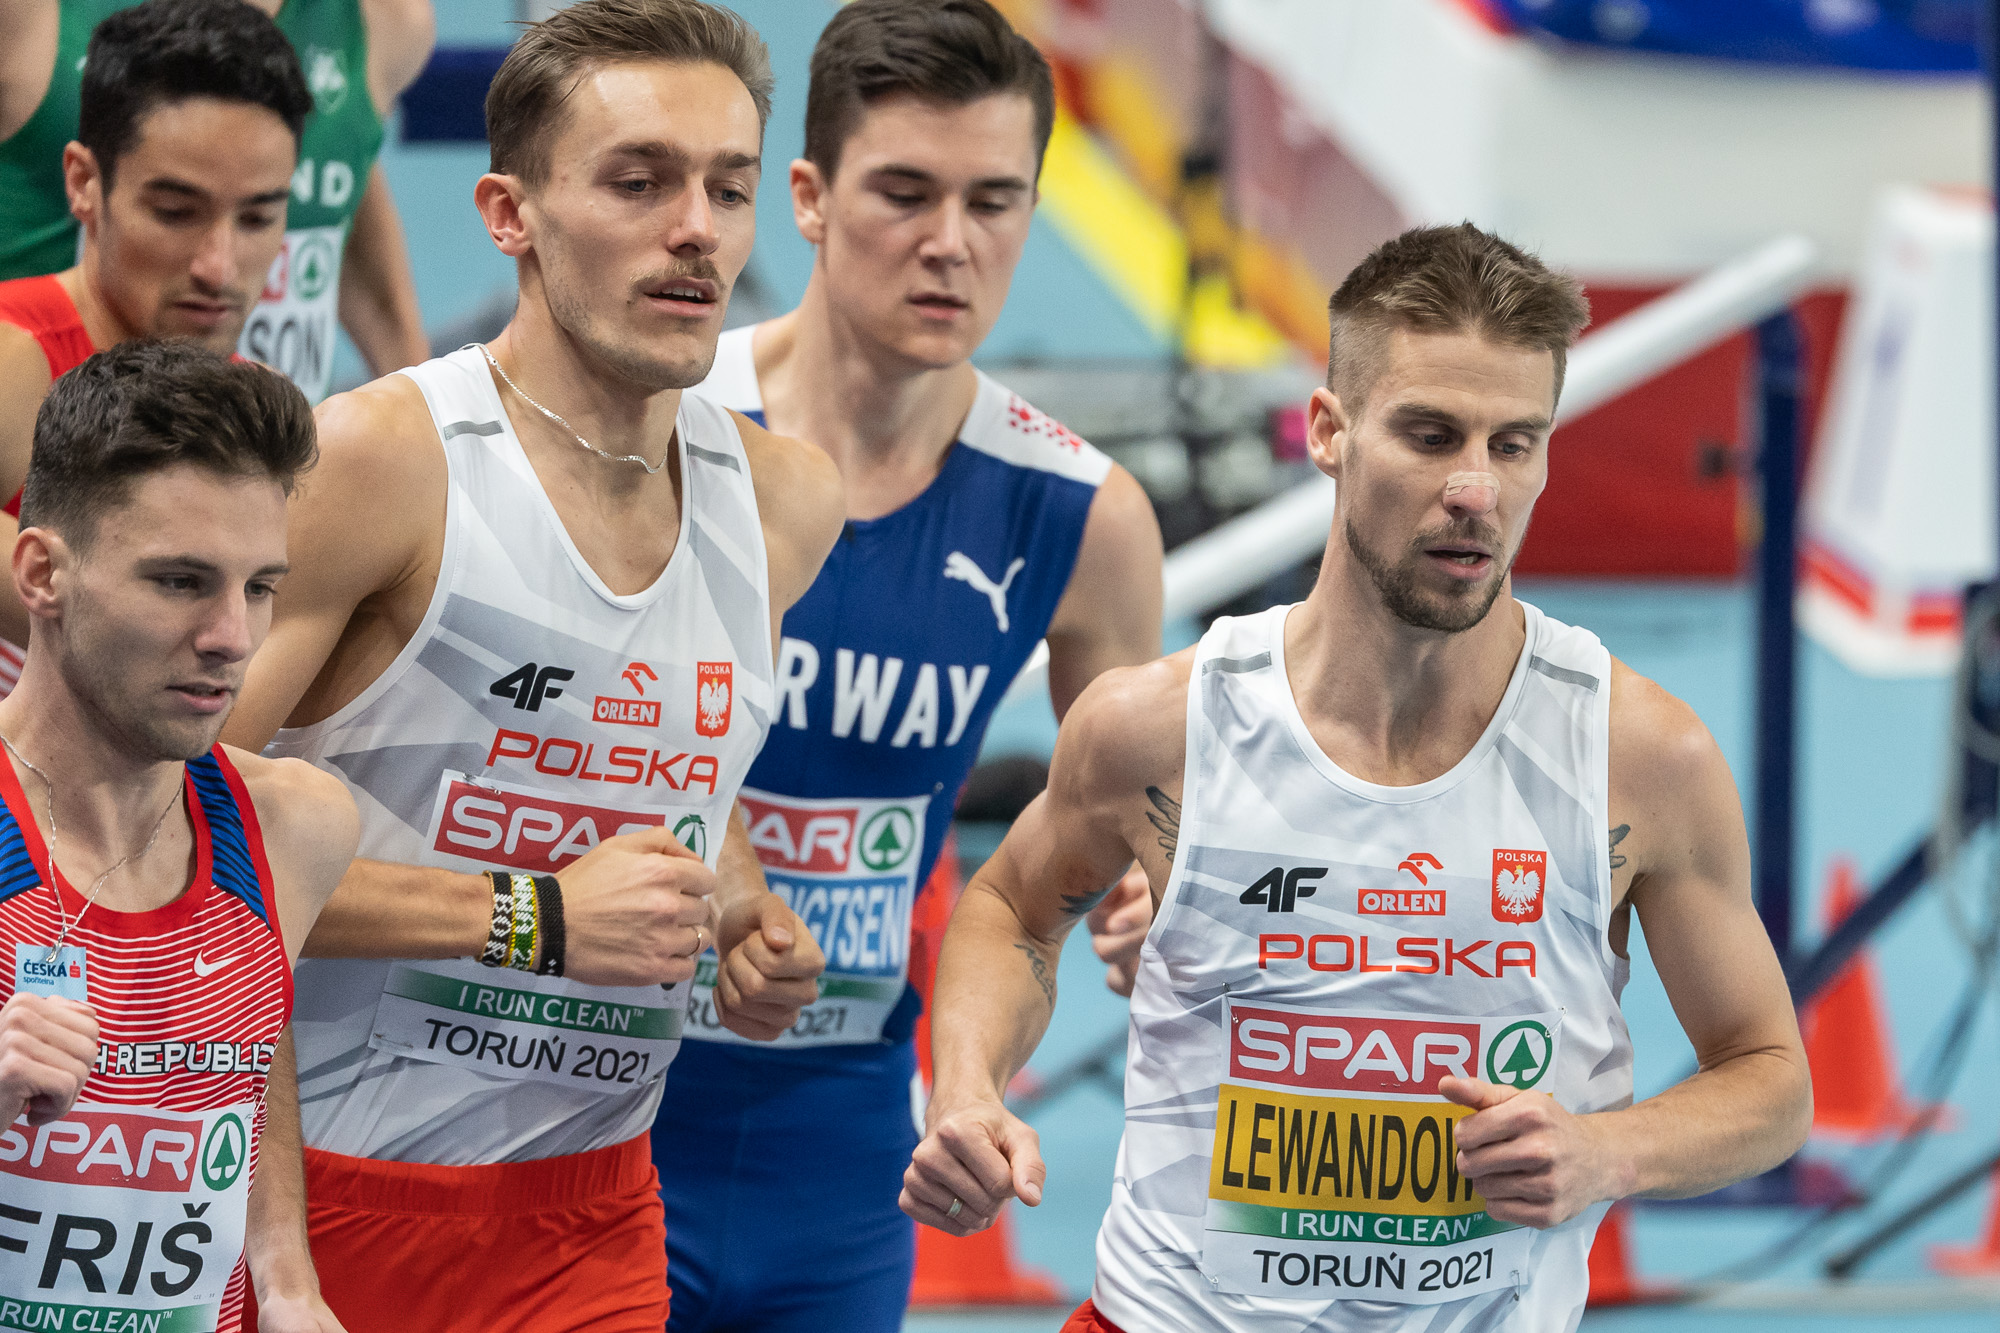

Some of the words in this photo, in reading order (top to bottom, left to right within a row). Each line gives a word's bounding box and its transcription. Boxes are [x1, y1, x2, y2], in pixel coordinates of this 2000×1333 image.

[289, 158, 354, 207] ND
[247, 315, 326, 383] SON
[489, 662, 575, 712] 4F
[699, 665, 731, 675] POLSKA
[769, 637, 990, 748] RWAY
[597, 700, 656, 723] ORLEN
[486, 727, 719, 795] POLSKA
[446, 795, 655, 862] SPA
[740, 806, 850, 864] AR
[1497, 852, 1543, 864] POLSKA
[1239, 866, 1329, 913] 4F
[1362, 892, 1441, 912] ORLEN
[23, 959, 67, 977] ČESKÁ
[1258, 933, 1537, 978] POLSKA
[458, 985, 468, 1006] I
[474, 988, 534, 1018] RUN
[790, 1006, 847, 1037] 021
[425, 1018, 567, 1073] TORUŃ
[571, 1045, 650, 1083] 2021
[1238, 1018, 1471, 1083] SPAR
[1222, 1100, 1473, 1203] LEWANDOW
[1281, 1212, 1288, 1234] I
[1298, 1213, 1363, 1237] RUN
[1253, 1250, 1406, 1290] TORUŃ
[1418, 1248, 1493, 1291] 2021
[0, 1301, 65, 1331] RUN
